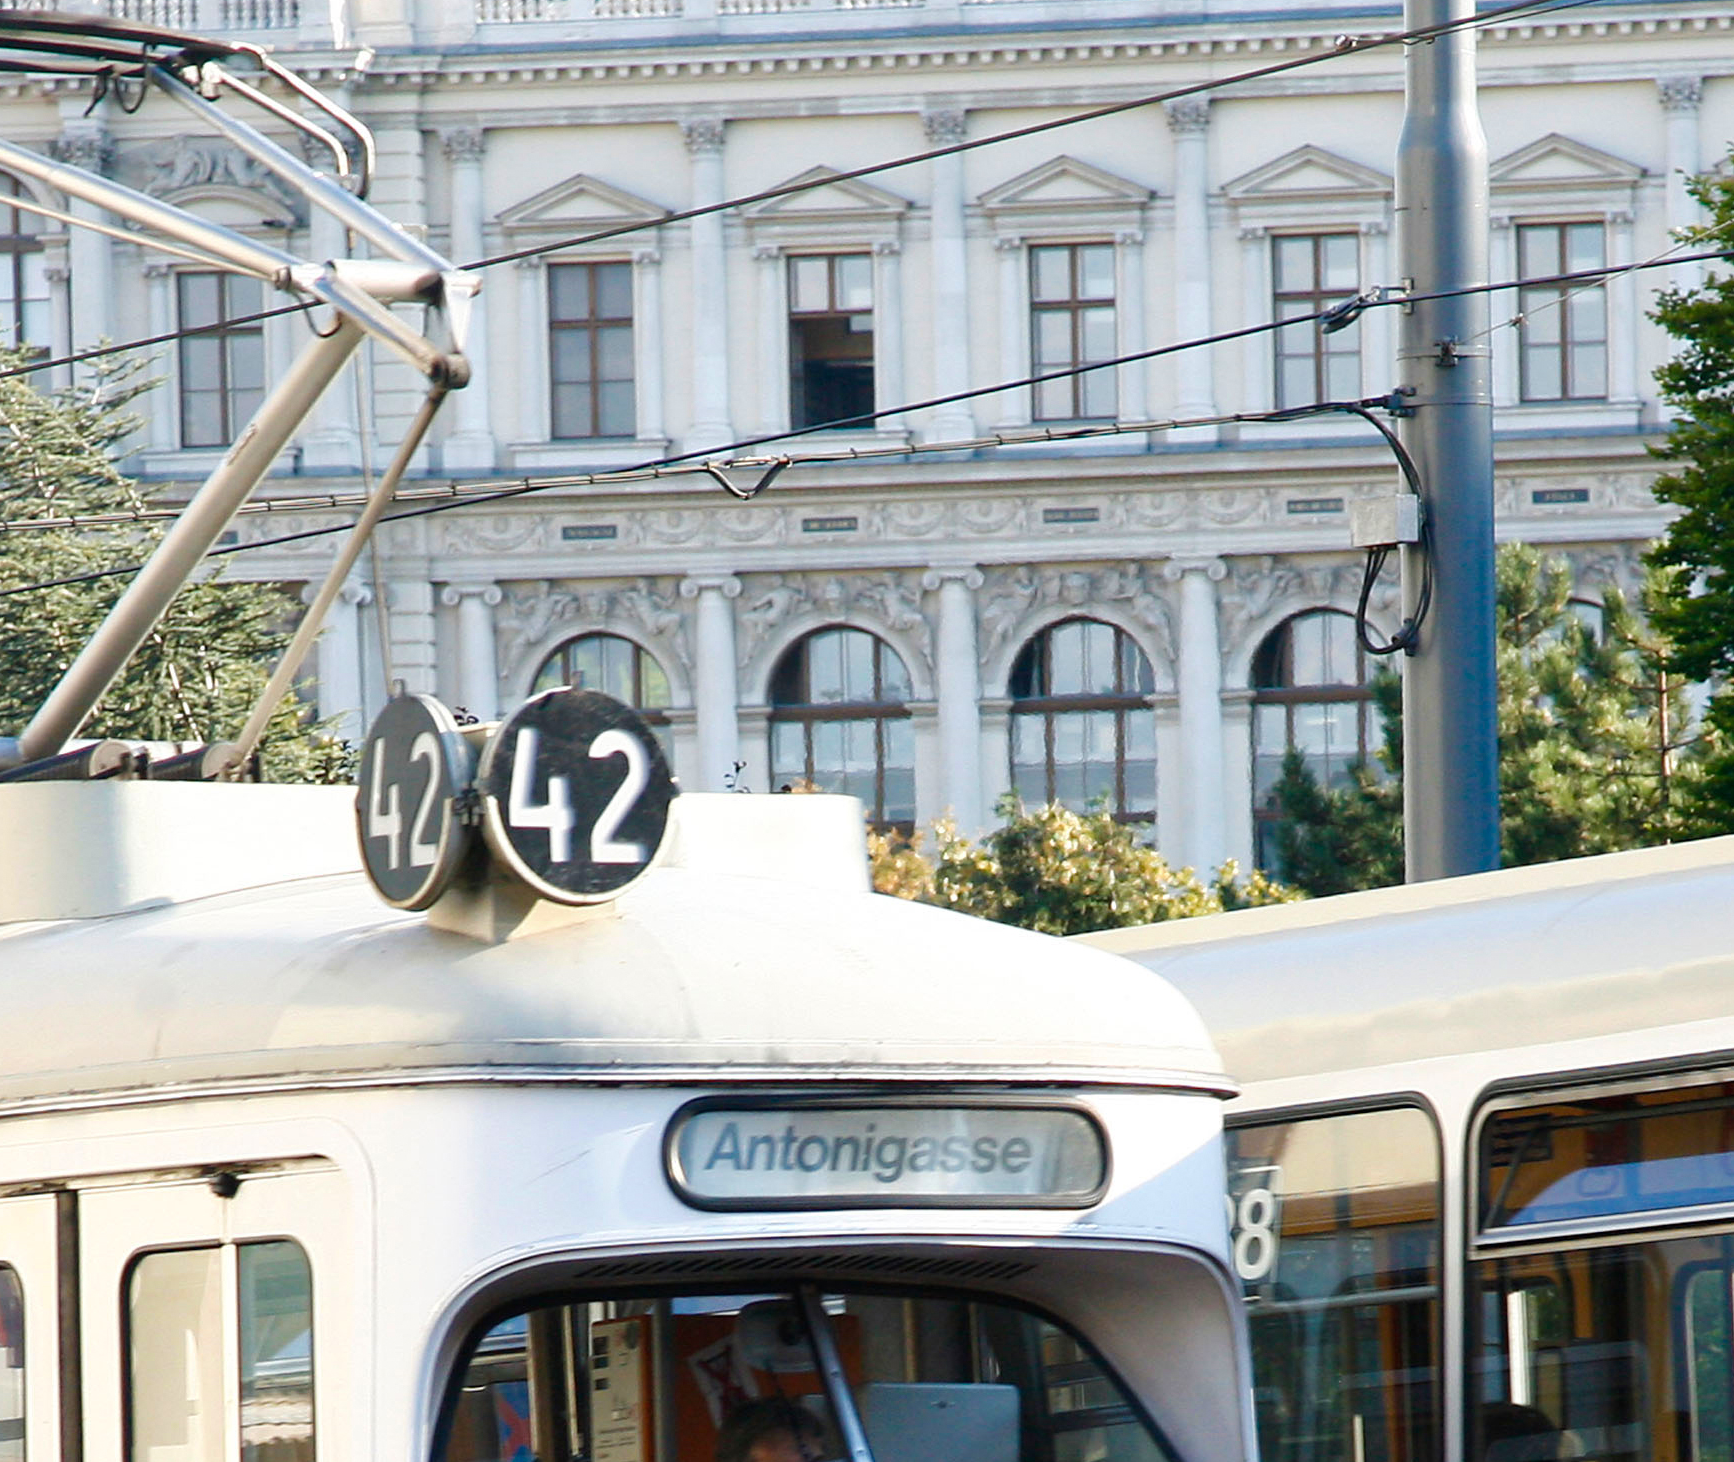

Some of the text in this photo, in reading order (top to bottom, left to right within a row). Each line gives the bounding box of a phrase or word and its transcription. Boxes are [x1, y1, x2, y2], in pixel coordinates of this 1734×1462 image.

[368, 730, 441, 870] 42
[508, 727, 649, 864] 42
[704, 1121, 1032, 1183] Antonigasse
[1224, 1188, 1275, 1280] 8
